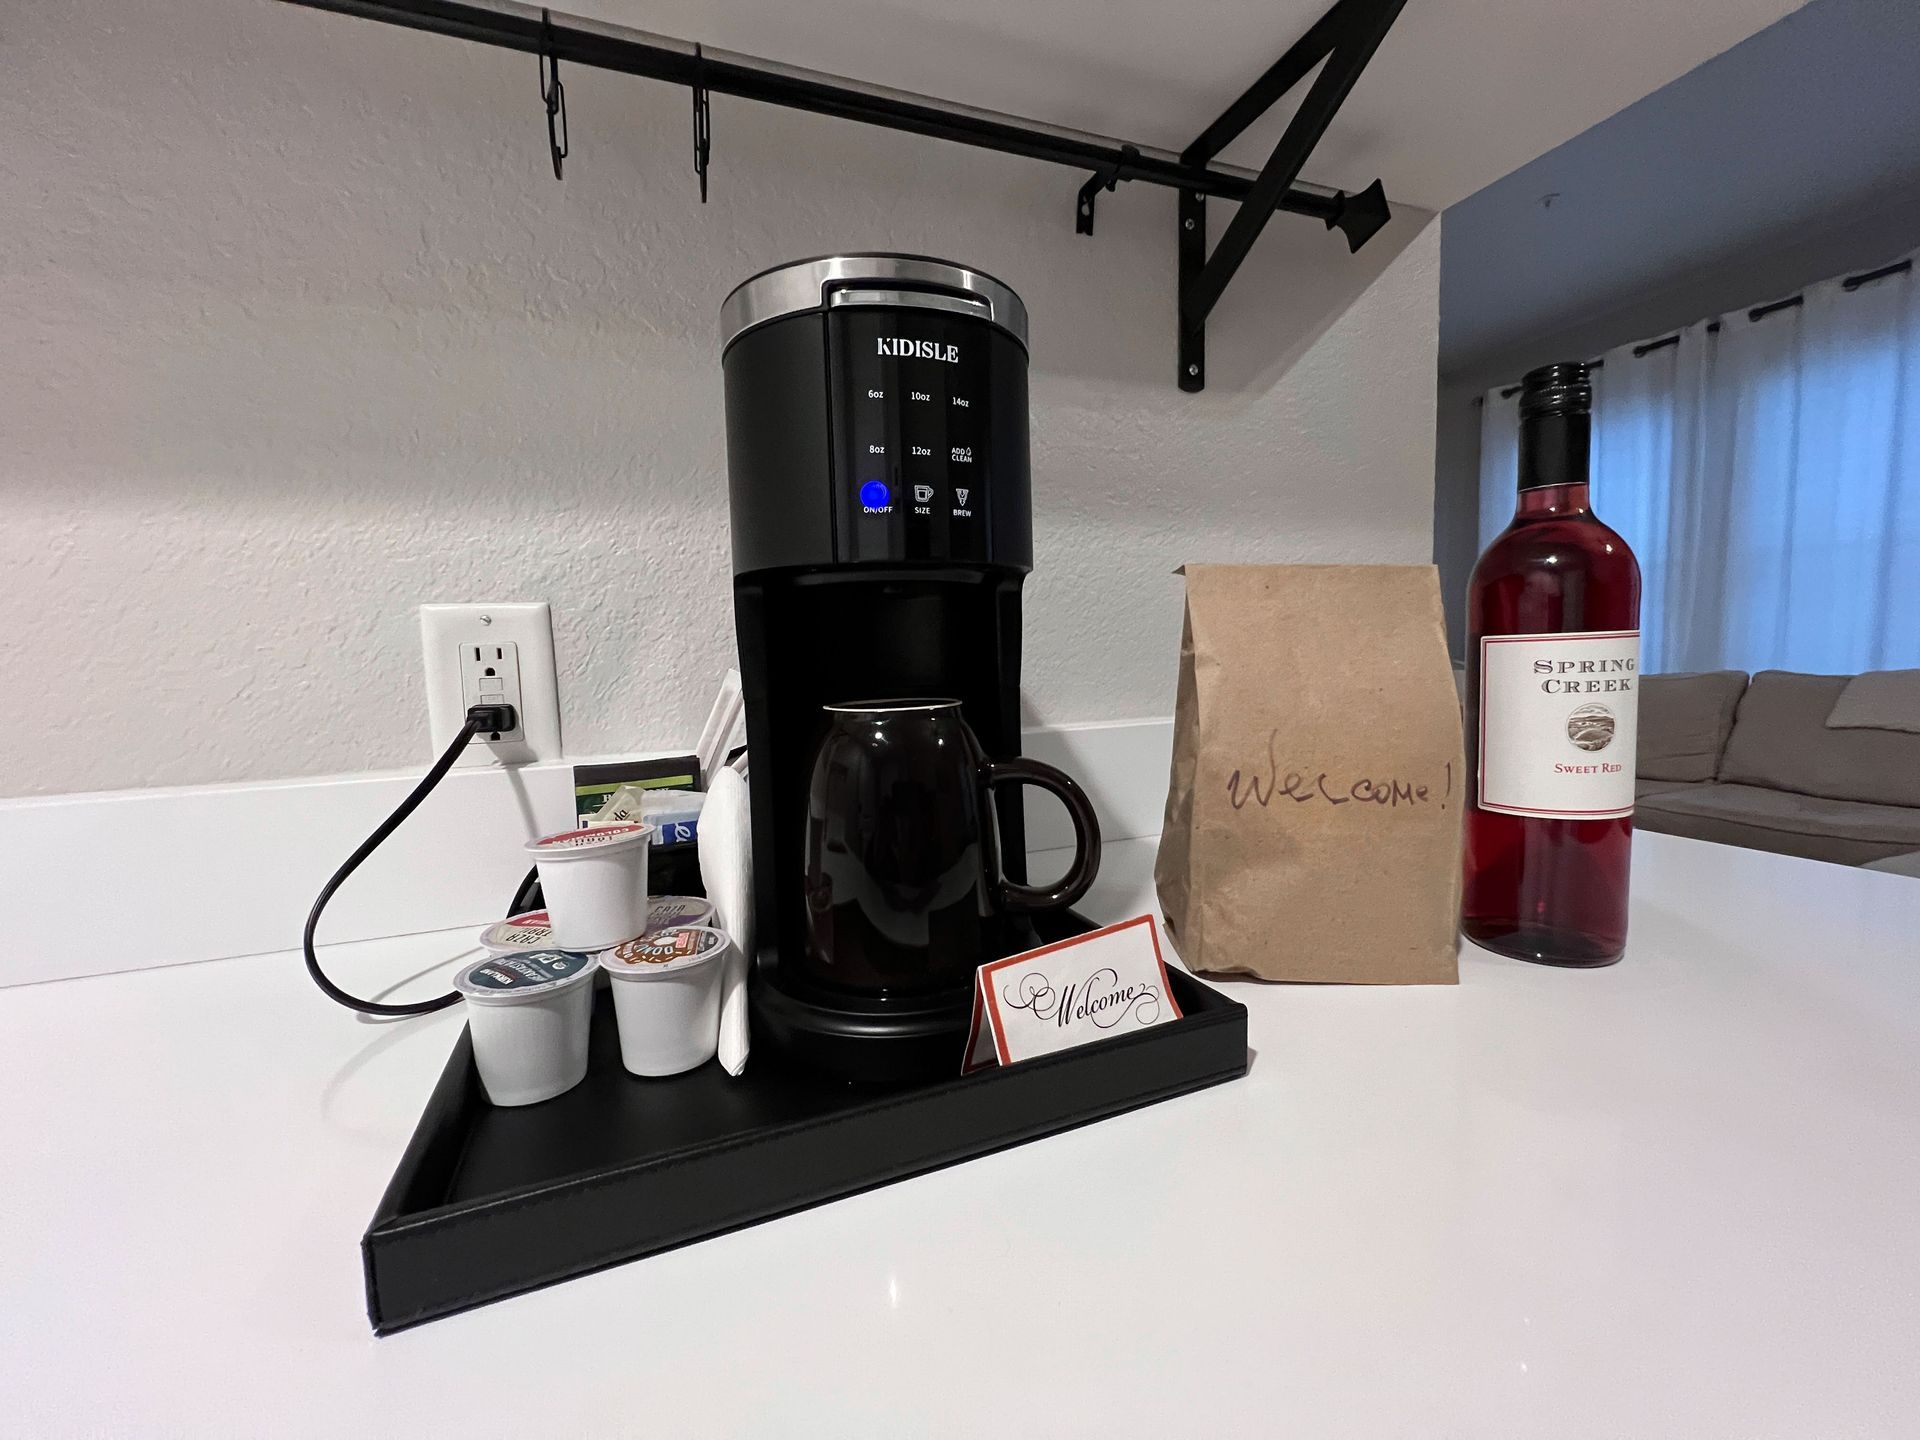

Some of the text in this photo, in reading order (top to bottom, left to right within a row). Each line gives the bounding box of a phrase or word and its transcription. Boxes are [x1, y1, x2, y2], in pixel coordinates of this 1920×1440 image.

[877, 337, 959, 364] KIDISLE
[868, 389, 884, 399] 6oz
[911, 391, 931, 402] 10oz
[952, 396, 969, 408] 14oz
[869, 445, 885, 454] 8oz
[912, 446, 931, 456] 12oz
[951, 447, 965, 455] ADD
[951, 454, 972, 463] CLEAN
[863, 506, 893, 514] ON/OFF
[914, 506, 931, 515] SIZE
[953, 508, 972, 517] BREW
[1533, 658, 1635, 675] SPRING
[1541, 678, 1631, 694] CREEK
[1554, 762, 1622, 774] SWEET RED
[1003, 967, 1160, 1029] Welcome
